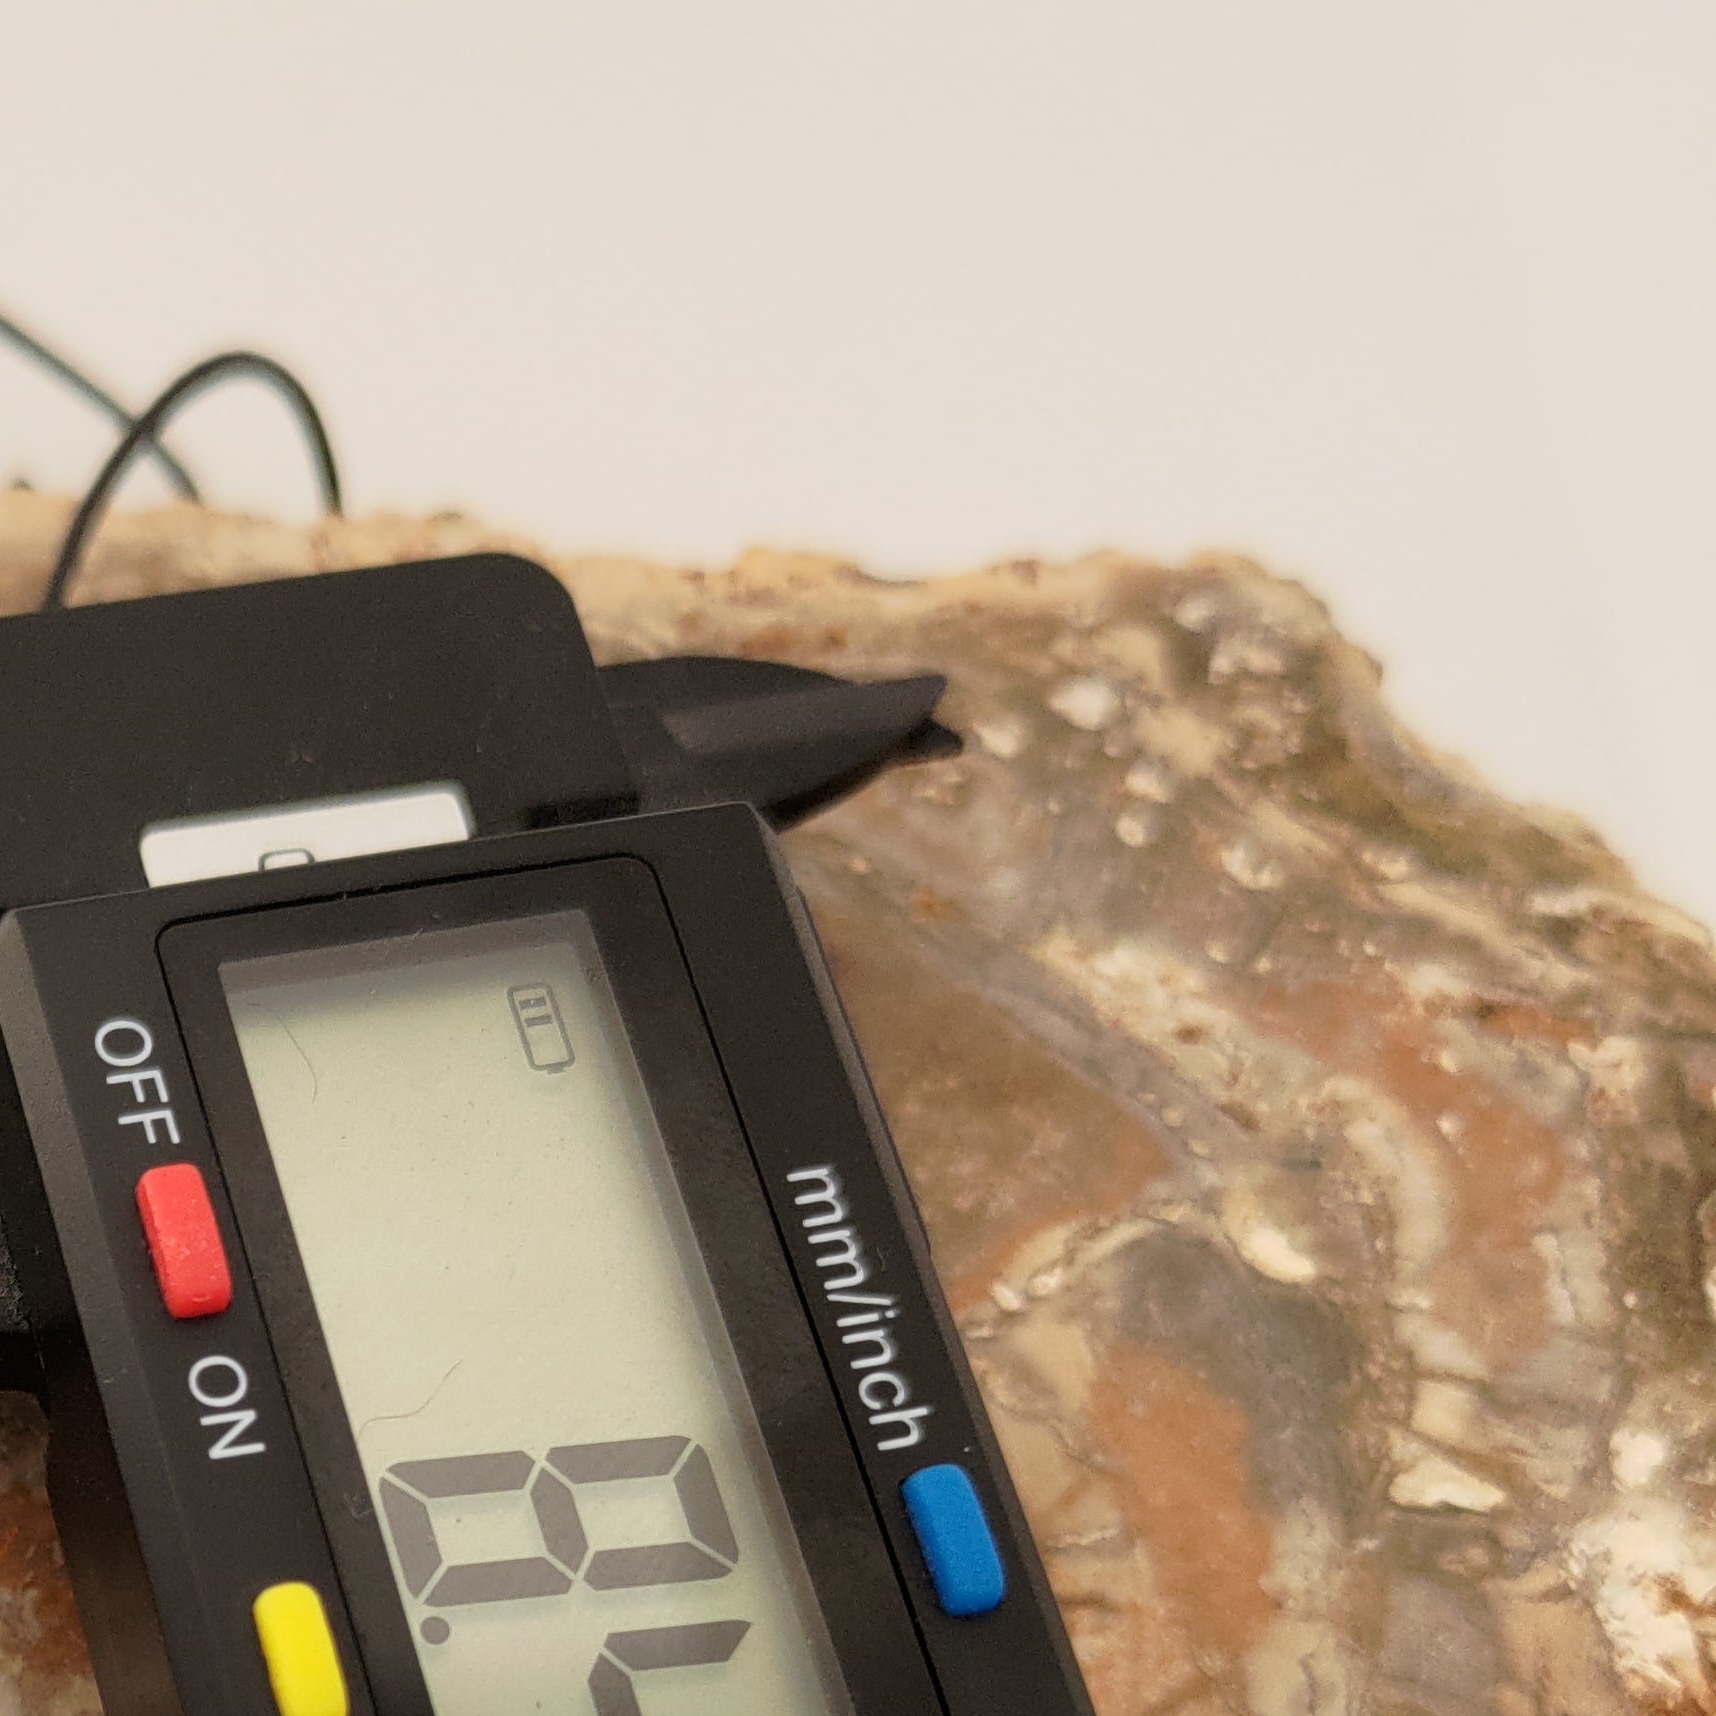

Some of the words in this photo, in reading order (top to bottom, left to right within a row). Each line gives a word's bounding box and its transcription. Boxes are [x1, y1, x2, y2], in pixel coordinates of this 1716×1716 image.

[95, 1019, 180, 1145] OFF
[786, 1166, 929, 1451] mm/inch
[188, 1355, 265, 1460] ON
